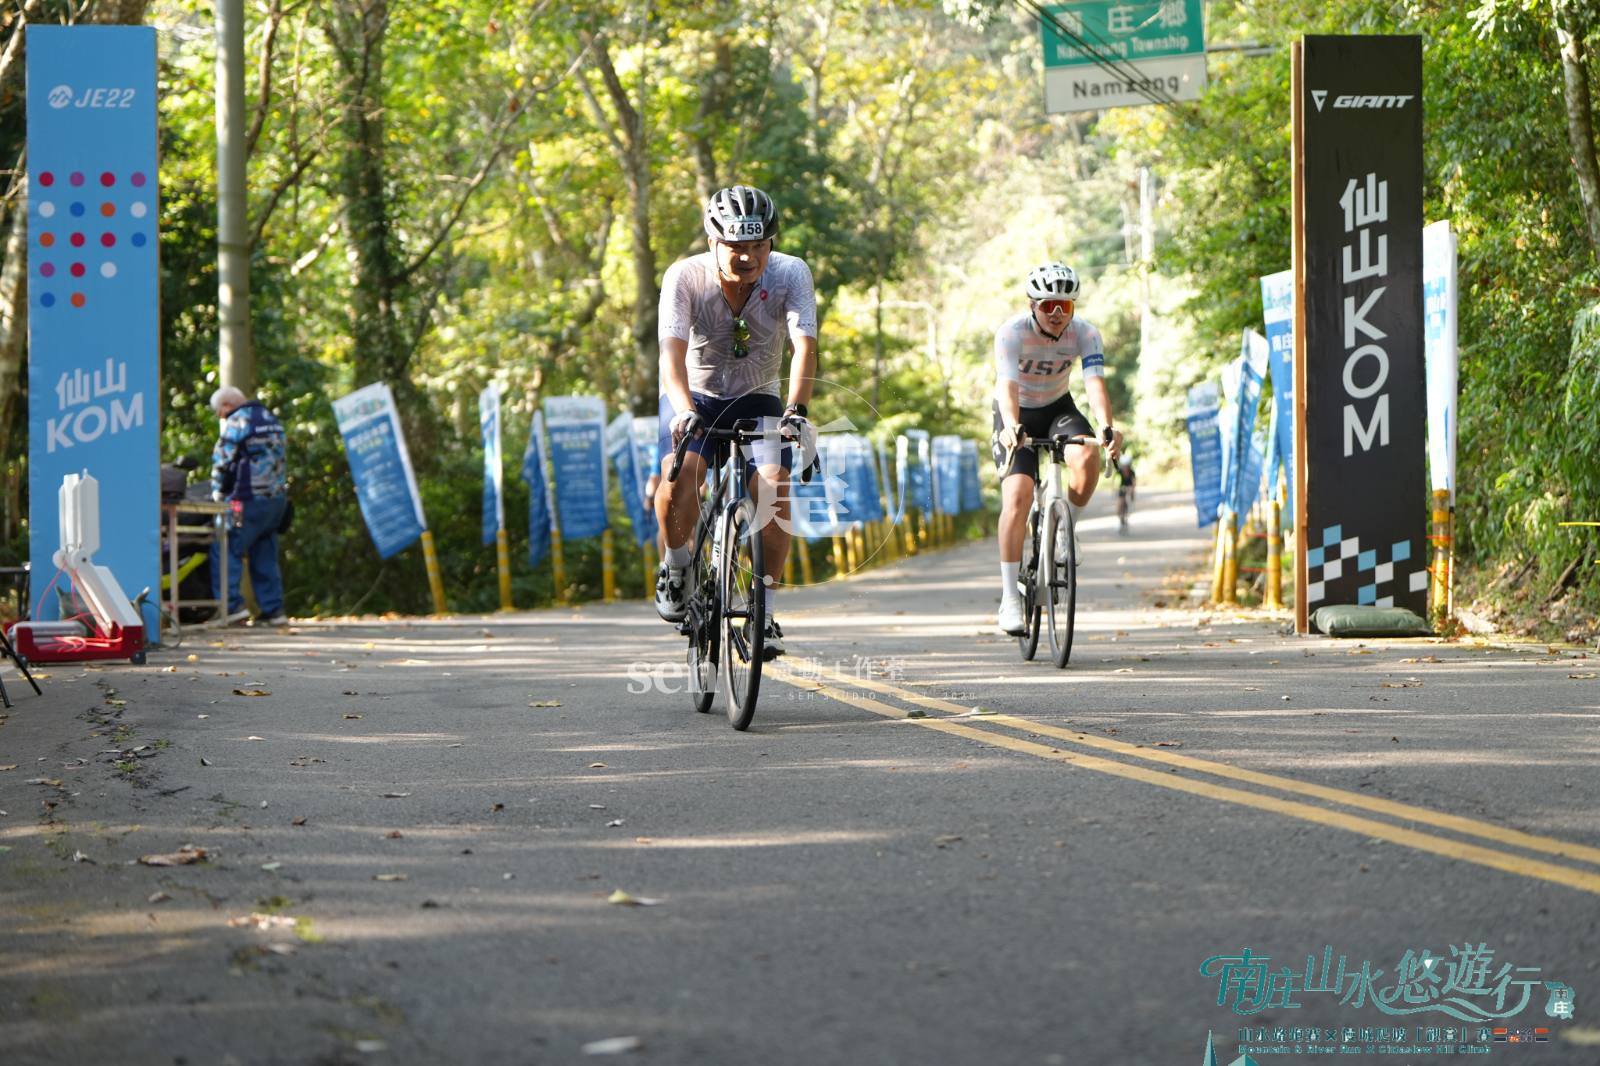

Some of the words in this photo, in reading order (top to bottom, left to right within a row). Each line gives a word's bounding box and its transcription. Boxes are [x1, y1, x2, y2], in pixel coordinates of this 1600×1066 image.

[75, 87, 136, 109] JE22
[1333, 94, 1415, 109] GIANT
[55, 357, 127, 411] 仙山
[1342, 287, 1390, 457] KOM
[46, 391, 144, 454] KOM
